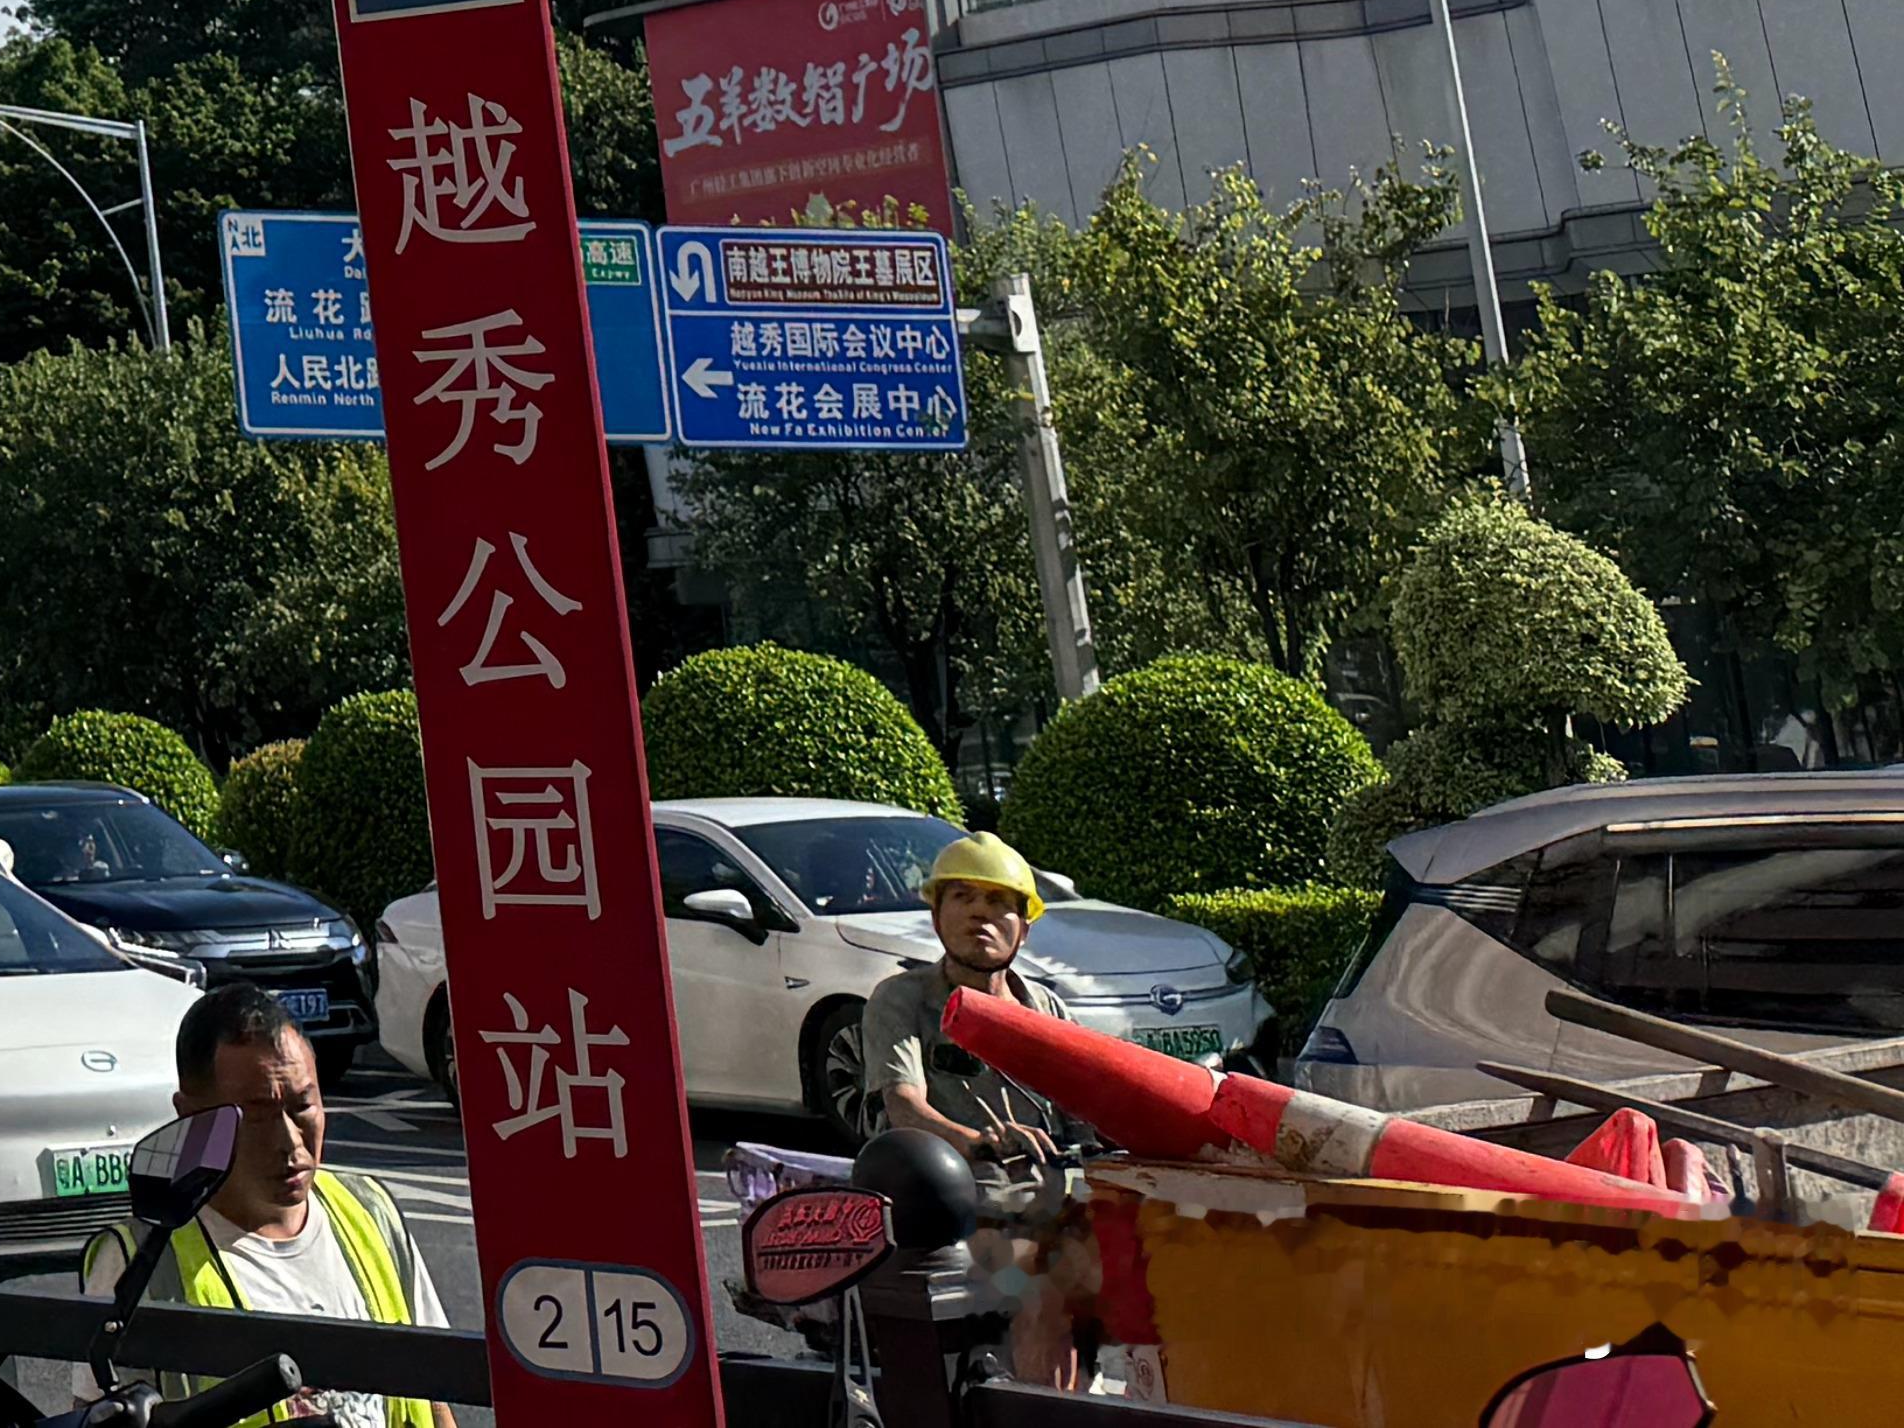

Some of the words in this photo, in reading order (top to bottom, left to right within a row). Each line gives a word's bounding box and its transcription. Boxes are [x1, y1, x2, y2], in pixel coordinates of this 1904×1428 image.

[663, 27, 934, 157] 五羊数智广场
[227, 218, 238, 232] N
[242, 226, 262, 248] 北
[580, 240, 635, 265] 高速
[726, 246, 936, 286] 南越王博物院王墓展区
[289, 327, 344, 340] Liuhua
[730, 320, 950, 360] 越秀国际会议中心
[733, 359, 776, 371] Yuexiu
[778, 360, 856, 373] International
[914, 362, 952, 374] Center
[271, 392, 327, 406] Renmin
[334, 392, 375, 406] North
[737, 382, 957, 423] 流花会展中心
[749, 423, 781, 436] New
[807, 423, 891, 437] Exhibition
[386, 93, 631, 1158] 越秀公园站
[532, 1295, 568, 1349] 2
[603, 1298, 663, 1356] 15
